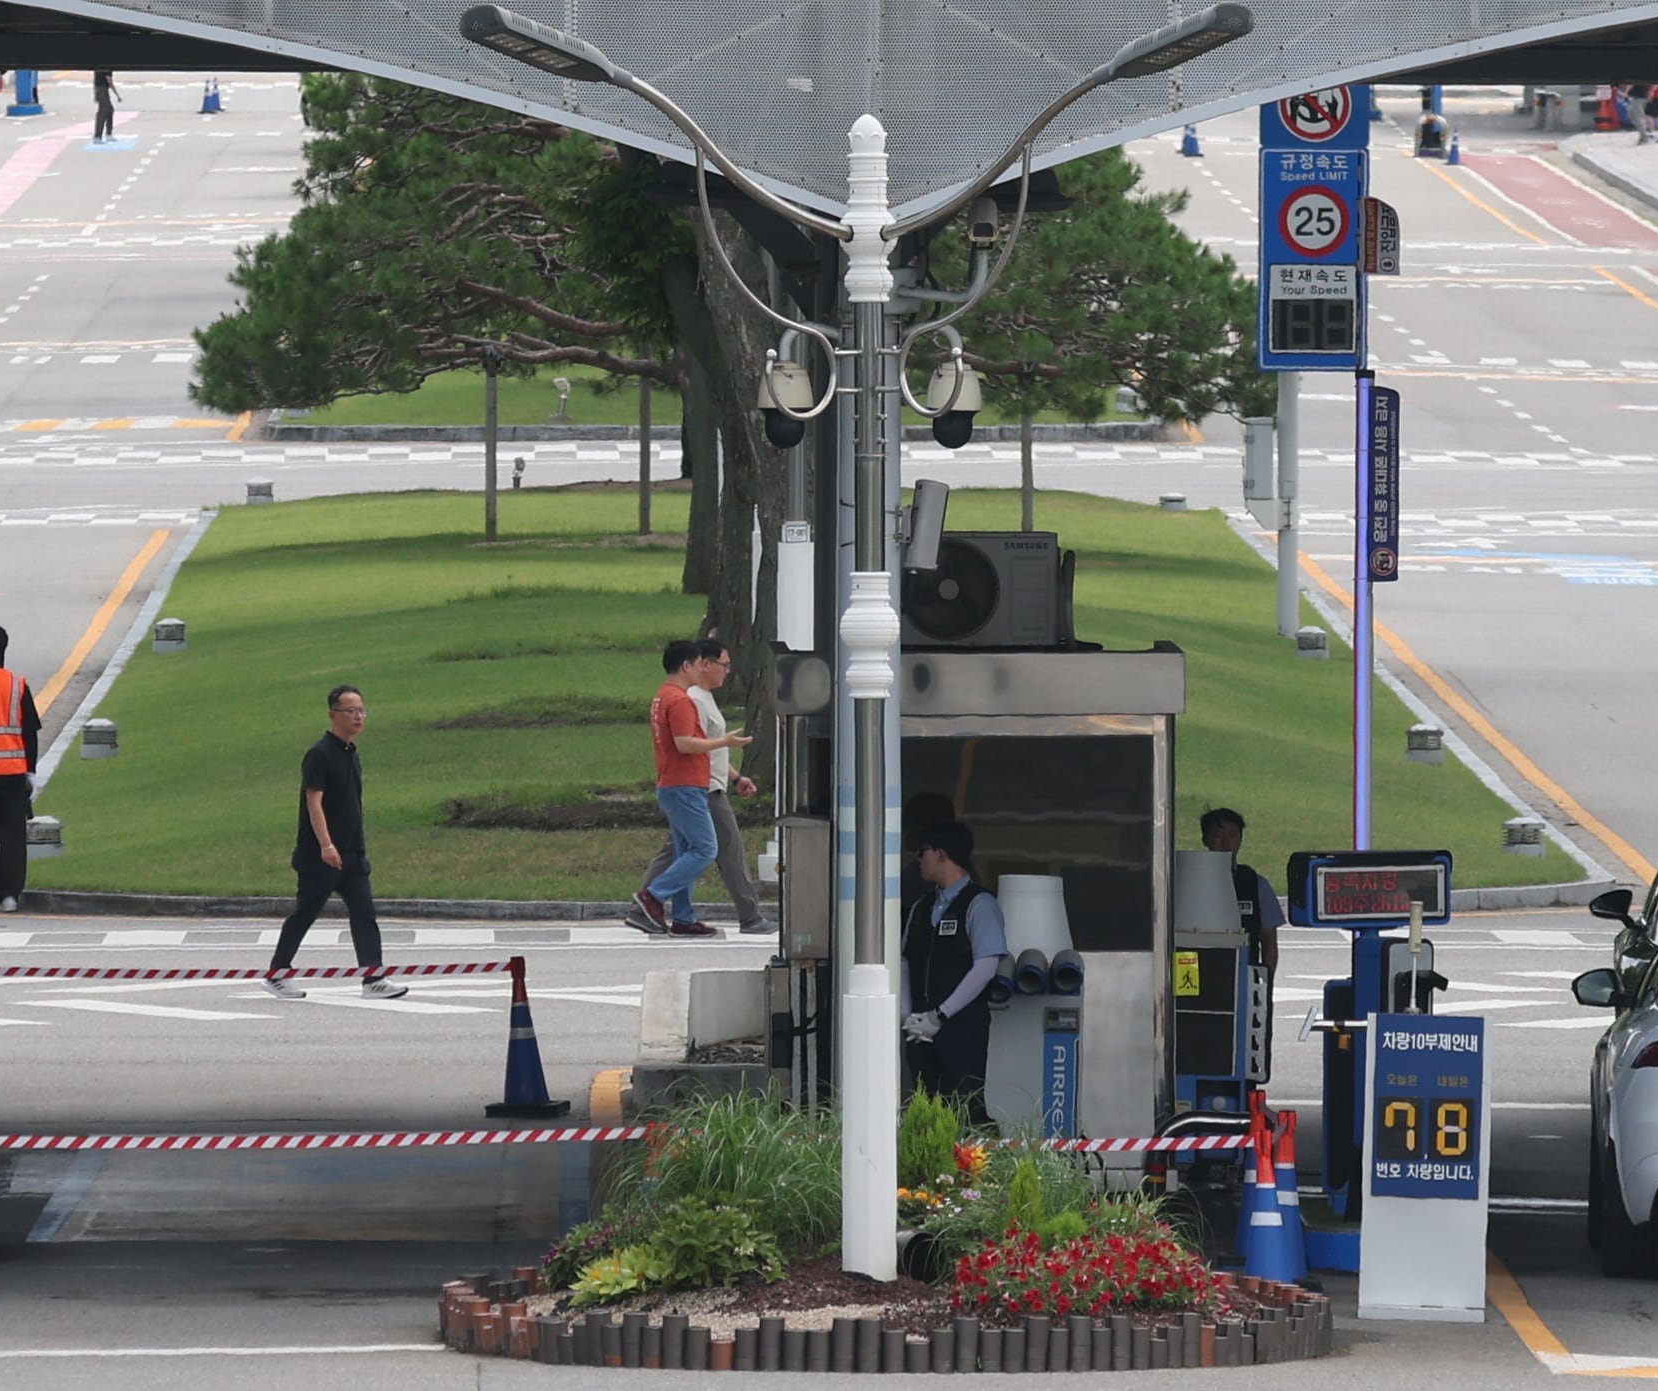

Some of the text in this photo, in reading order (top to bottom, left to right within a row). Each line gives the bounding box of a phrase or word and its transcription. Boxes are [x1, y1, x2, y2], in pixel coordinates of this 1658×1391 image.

[1280, 154, 1348, 170] 규정속도
[1280, 171, 1349, 182] Speed LIMIT
[1294, 206, 1336, 236] 25
[1280, 268, 1348, 283] 현재속도
[1281, 284, 1347, 295] Your Speed
[1375, 396, 1389, 421] 금지
[1374, 426, 1388, 452] 사용
[1374, 455, 1388, 496] 휴대폰
[1373, 516, 1388, 543] 운전
[1382, 1031, 1479, 1053] 차량10부제안내
[1051, 1045, 1066, 1139] AIRREX
[1376, 1162, 1474, 1180] 번호 차량입니다.
